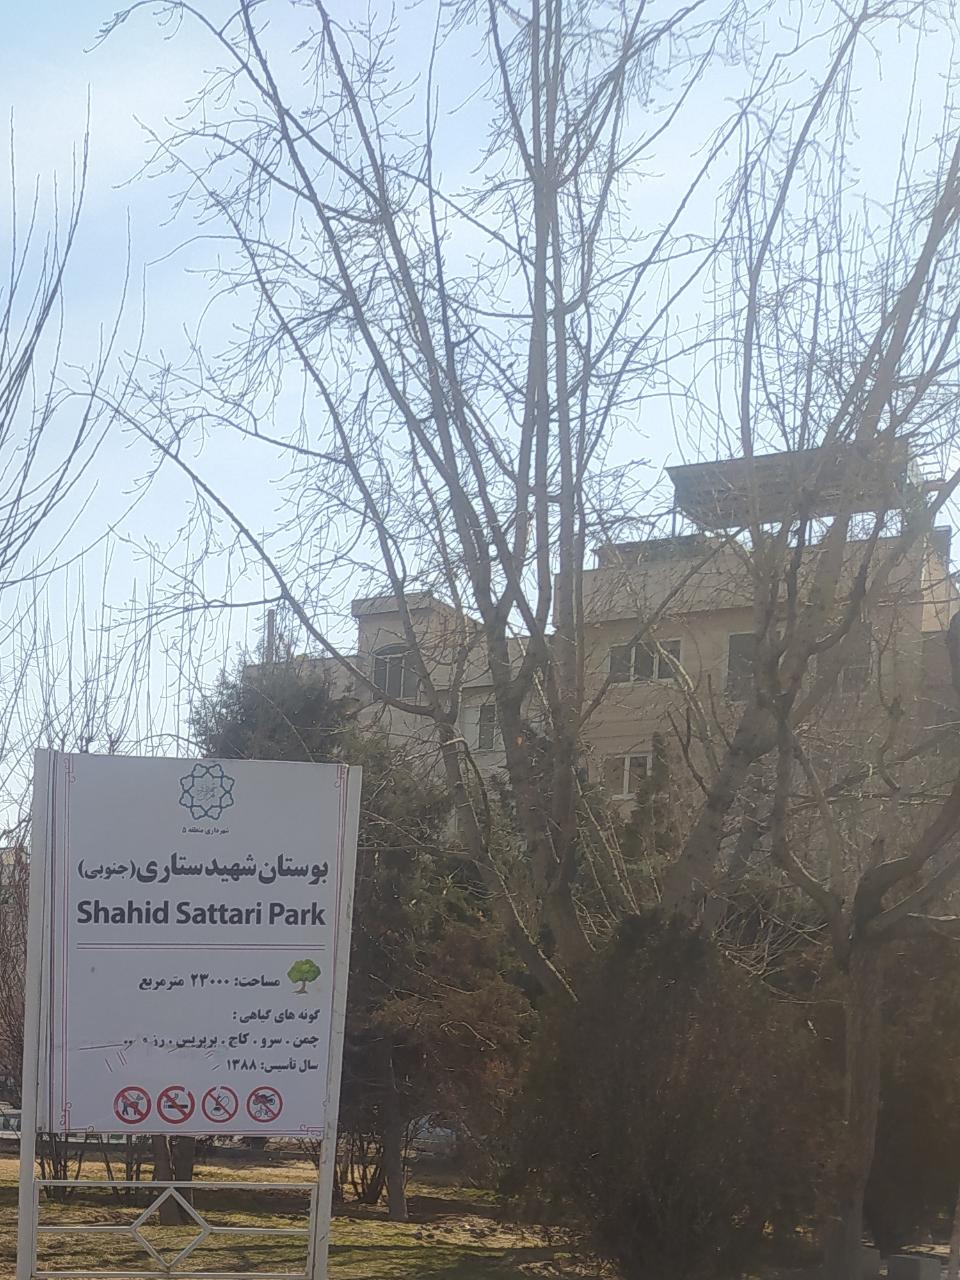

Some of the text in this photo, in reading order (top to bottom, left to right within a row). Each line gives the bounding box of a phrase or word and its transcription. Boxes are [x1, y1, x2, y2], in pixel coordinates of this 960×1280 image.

[77, 852, 329, 885] بوستان شهید ستاری (جنوبی)
[77, 900, 327, 926] Shahid Sattari Park
[190, 973, 230, 988] ۲۳۰۰۰
[234, 974, 281, 988] مساحت:
[274, 1009, 296, 1024] های
[298, 1009, 321, 1024] گونه
[227, 1058, 257, 1071] ۱۳۸۸
[299, 1059, 319, 1073] سال
